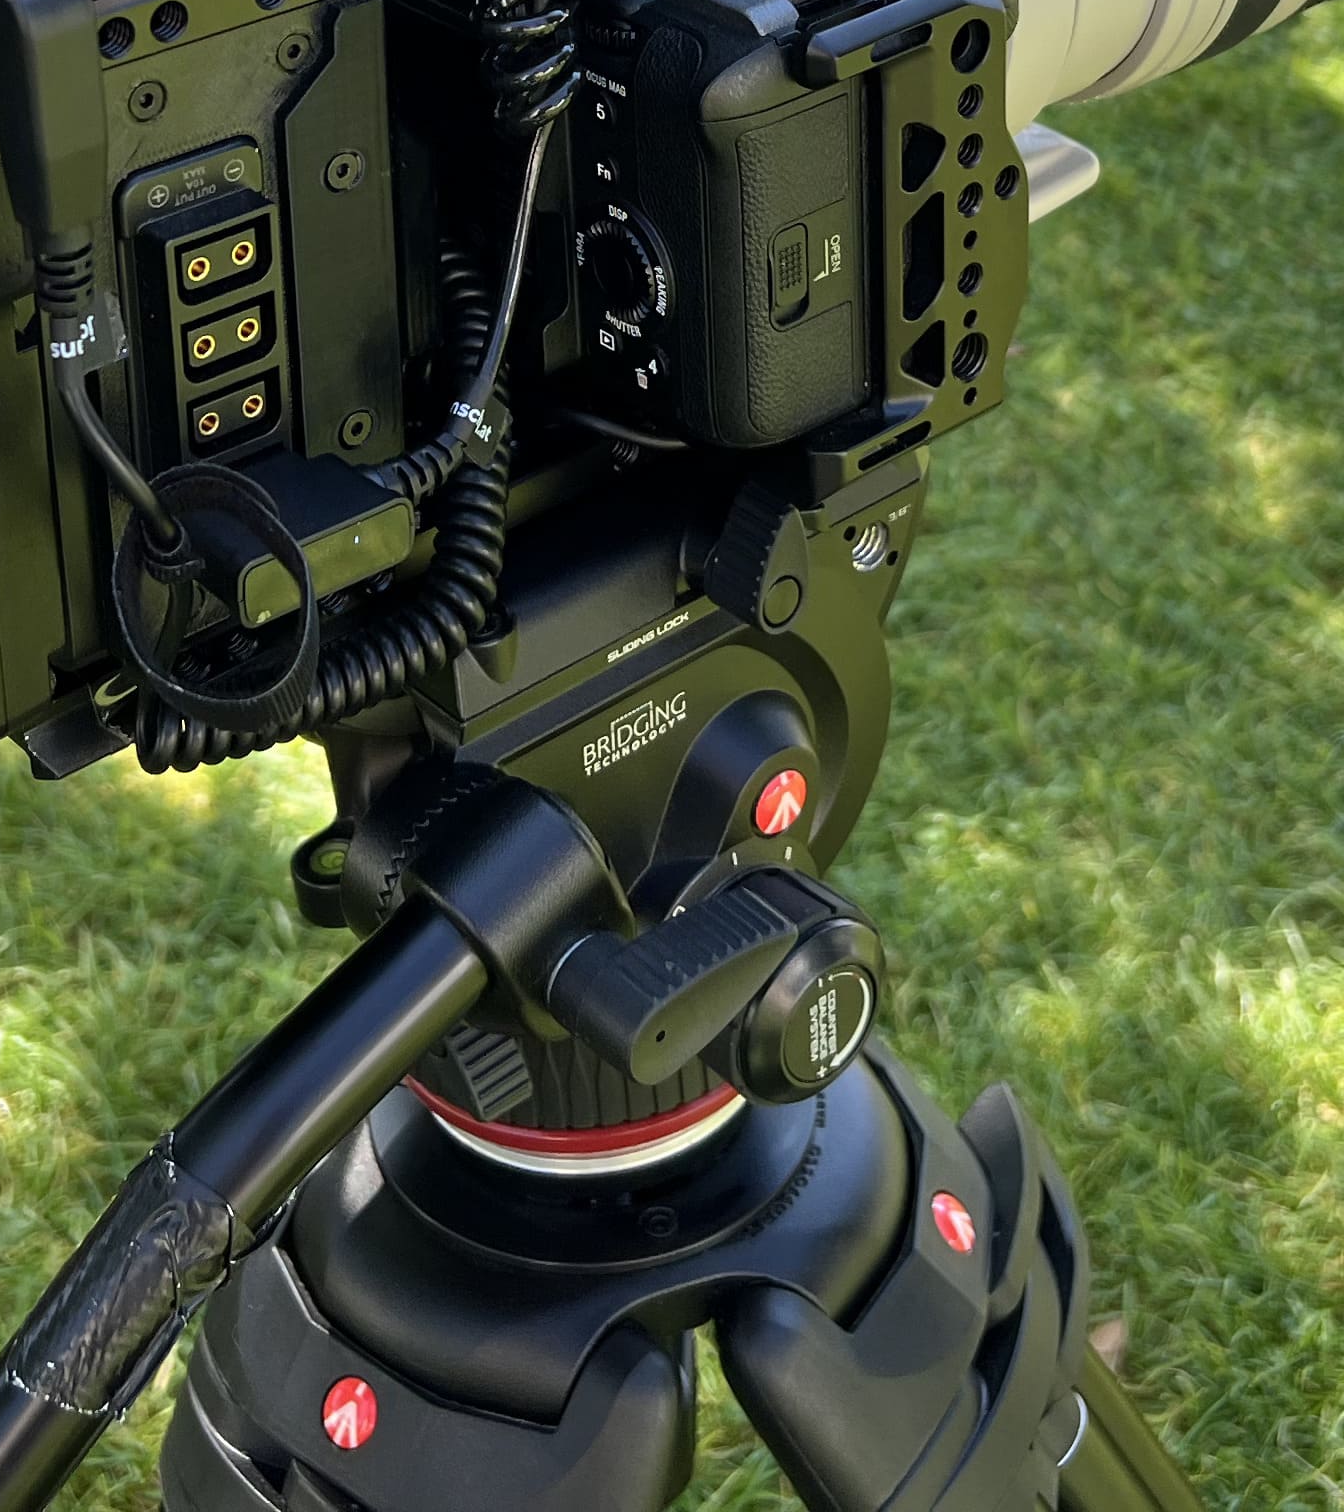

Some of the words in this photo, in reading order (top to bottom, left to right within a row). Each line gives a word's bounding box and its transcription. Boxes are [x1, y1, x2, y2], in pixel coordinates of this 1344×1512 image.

[585, 70, 607, 88] OCUS
[608, 80, 627, 97] MAG
[596, 102, 606, 120] 5
[597, 162, 612, 181] Fn
[608, 204, 629, 222] DISP
[830, 234, 842, 273] OPEN
[653, 265, 668, 317] PEAKING
[605, 310, 642, 338] SHUTTER
[648, 359, 658, 375] 4
[607, 629, 655, 663] SLIDING
[656, 611, 689, 636] LOCK
[583, 691, 687, 767] BRIDGING
[809, 1004, 819, 1063] SYSTEM
[818, 994, 828, 1061] BALANCE
[827, 989, 836, 1055] COUNTER
